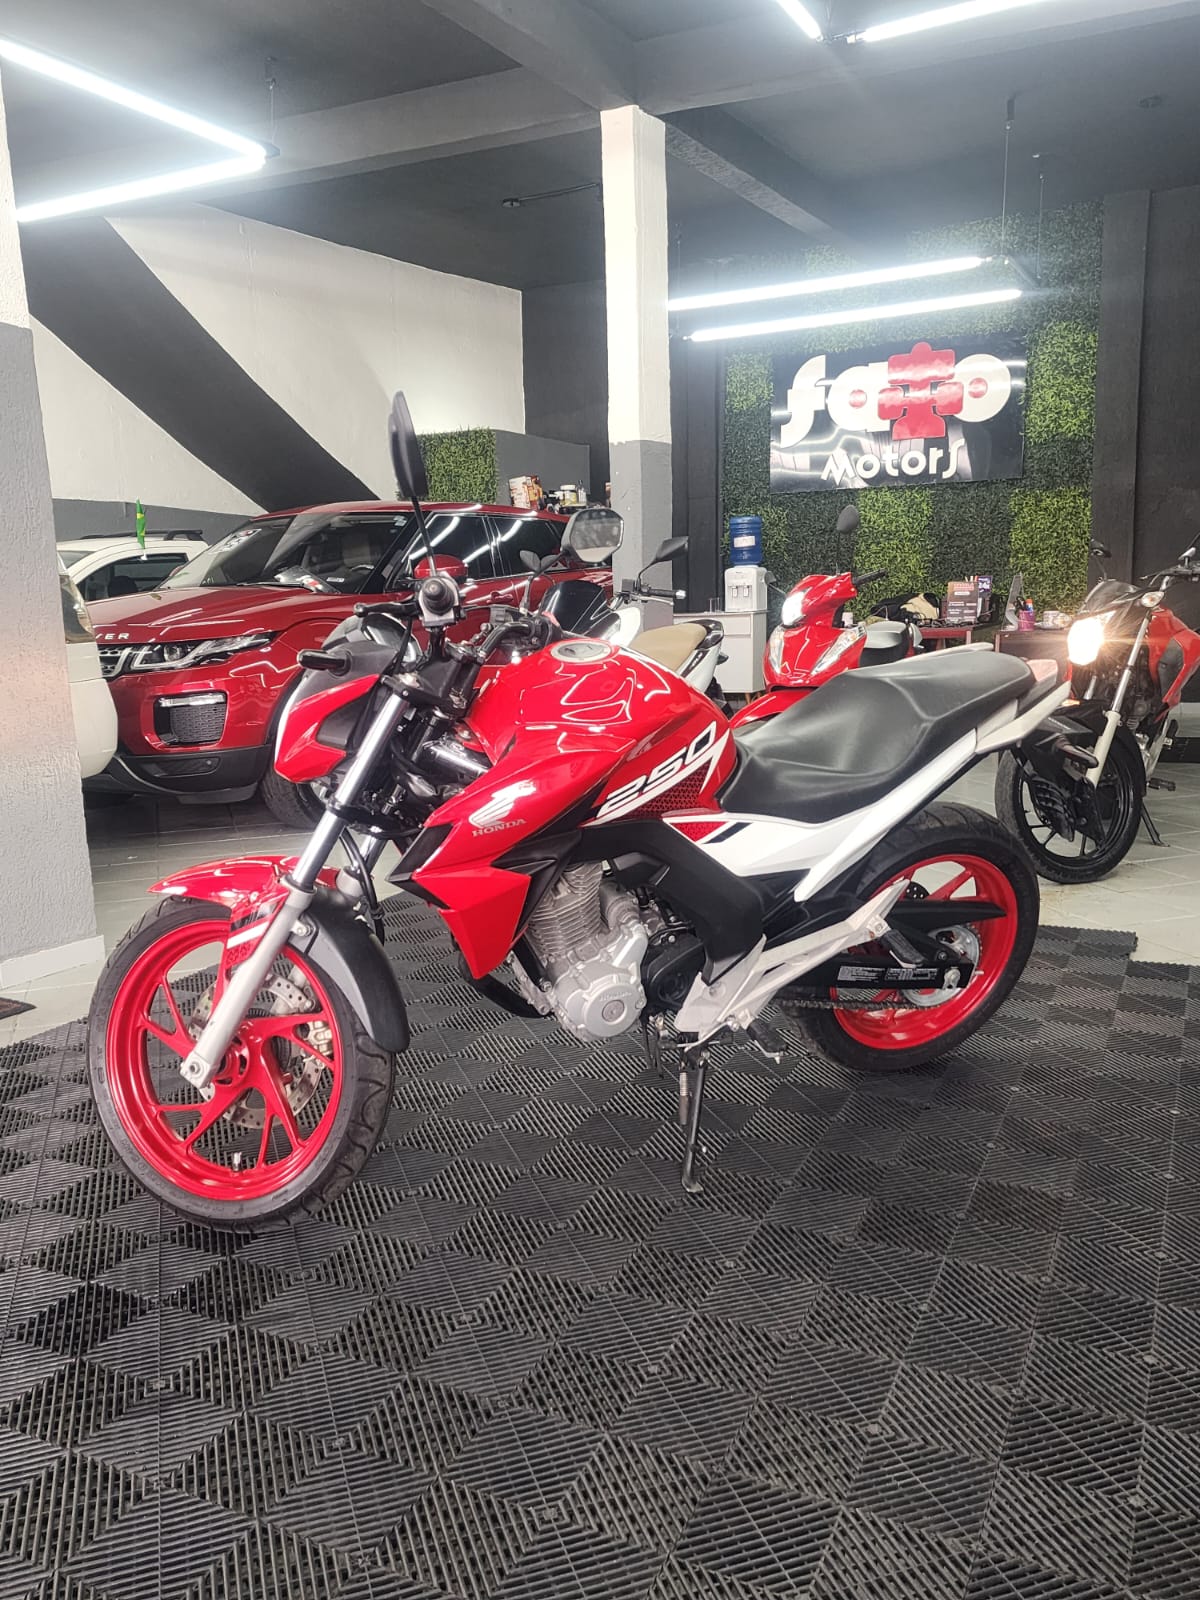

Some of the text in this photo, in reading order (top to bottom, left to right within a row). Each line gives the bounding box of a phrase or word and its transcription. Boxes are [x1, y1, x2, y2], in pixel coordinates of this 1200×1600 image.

[820, 438, 965, 486] Motors
[596, 720, 717, 818] 250
[472, 819, 527, 837] HONDA
